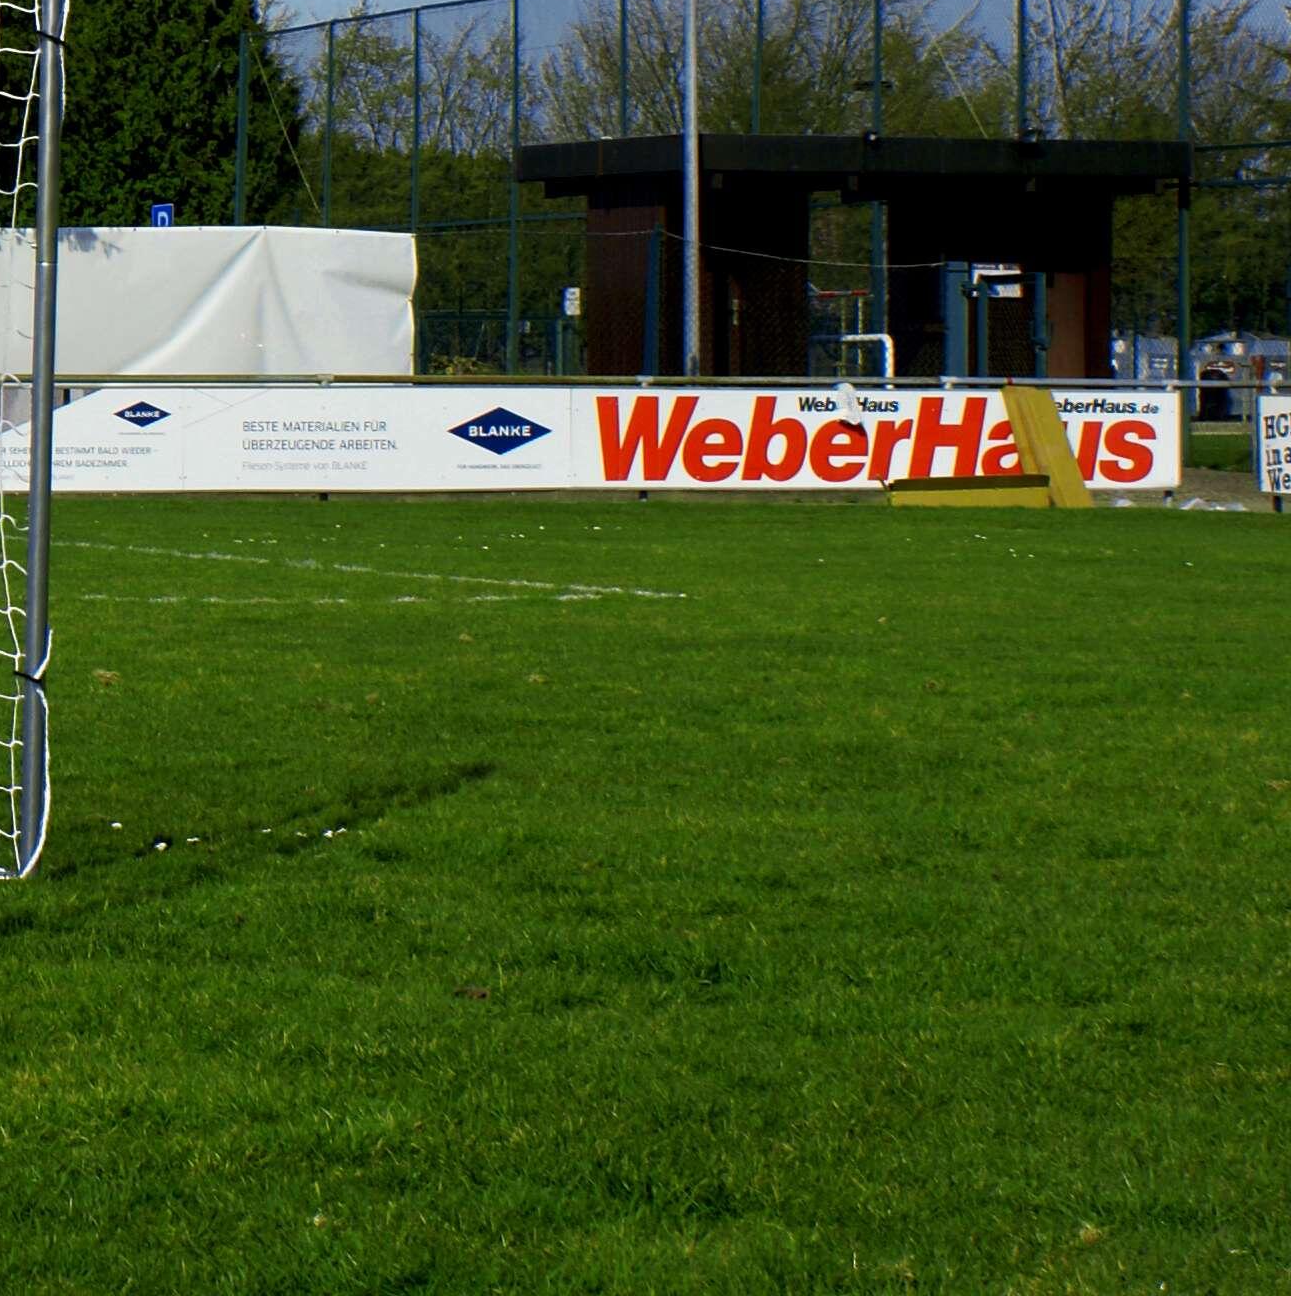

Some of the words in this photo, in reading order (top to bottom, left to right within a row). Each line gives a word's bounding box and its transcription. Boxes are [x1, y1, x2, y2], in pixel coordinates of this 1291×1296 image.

[798, 396, 900, 412] WebHaus
[1056, 398, 1160, 414] eberHaus.de
[124, 410, 160, 418] BLANKE
[242, 421, 279, 432] BESTE
[283, 421, 361, 432] MATERIALIEN
[363, 419, 387, 432] FÜR
[468, 425, 532, 437] BLANKE
[242, 438, 336, 450] ÜBERZEUGENDE
